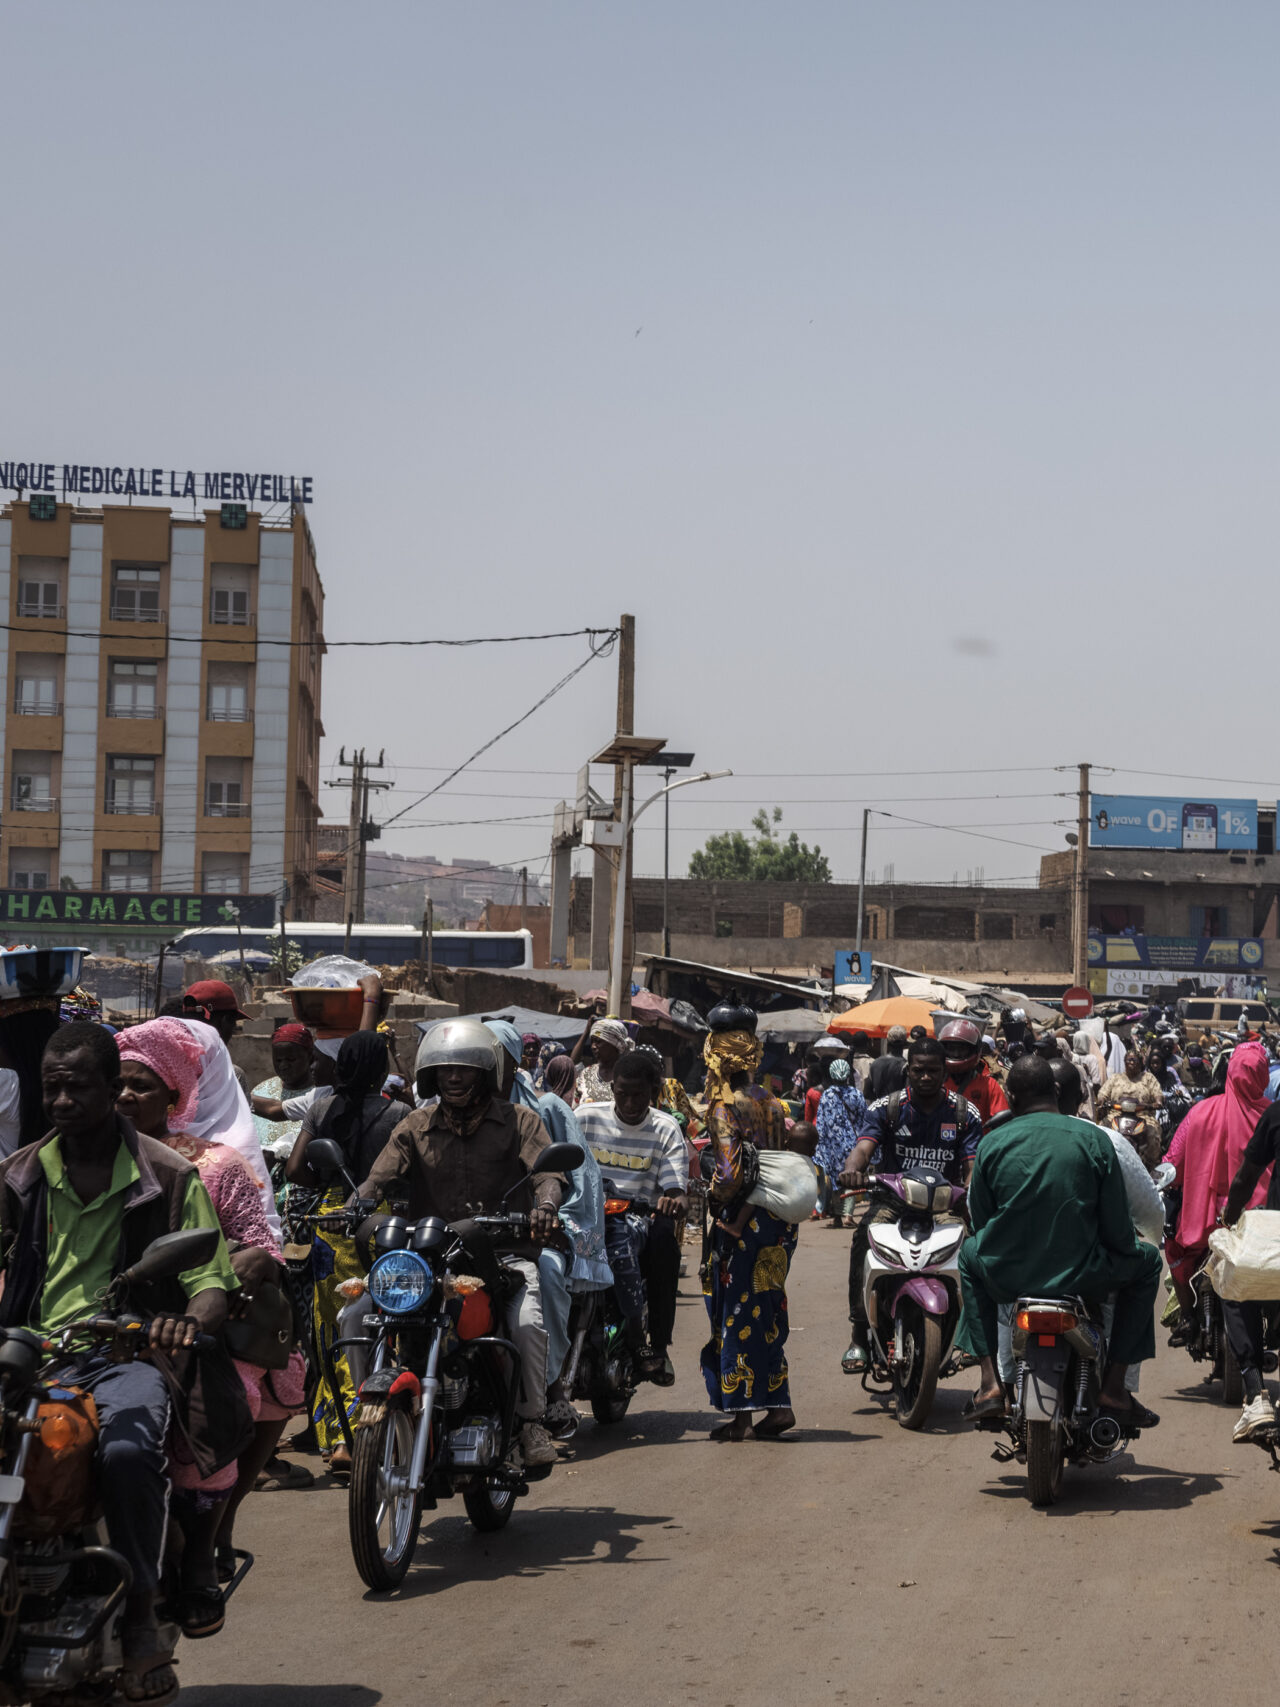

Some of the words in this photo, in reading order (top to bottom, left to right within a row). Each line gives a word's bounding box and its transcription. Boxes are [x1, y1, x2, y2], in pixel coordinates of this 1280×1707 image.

[63, 464, 163, 496] MEDICALE
[170, 470, 196, 498] LA
[205, 472, 314, 503] MERVEILLE
[1110, 815, 1142, 826] wave
[1221, 810, 1250, 834] 1%
[0, 893, 202, 922] HARMACIE
[843, 975, 866, 983] wave
[942, 1130, 954, 1138] OL
[895, 1143, 955, 1161] Emirates
[901, 1157, 917, 1170] FLY
